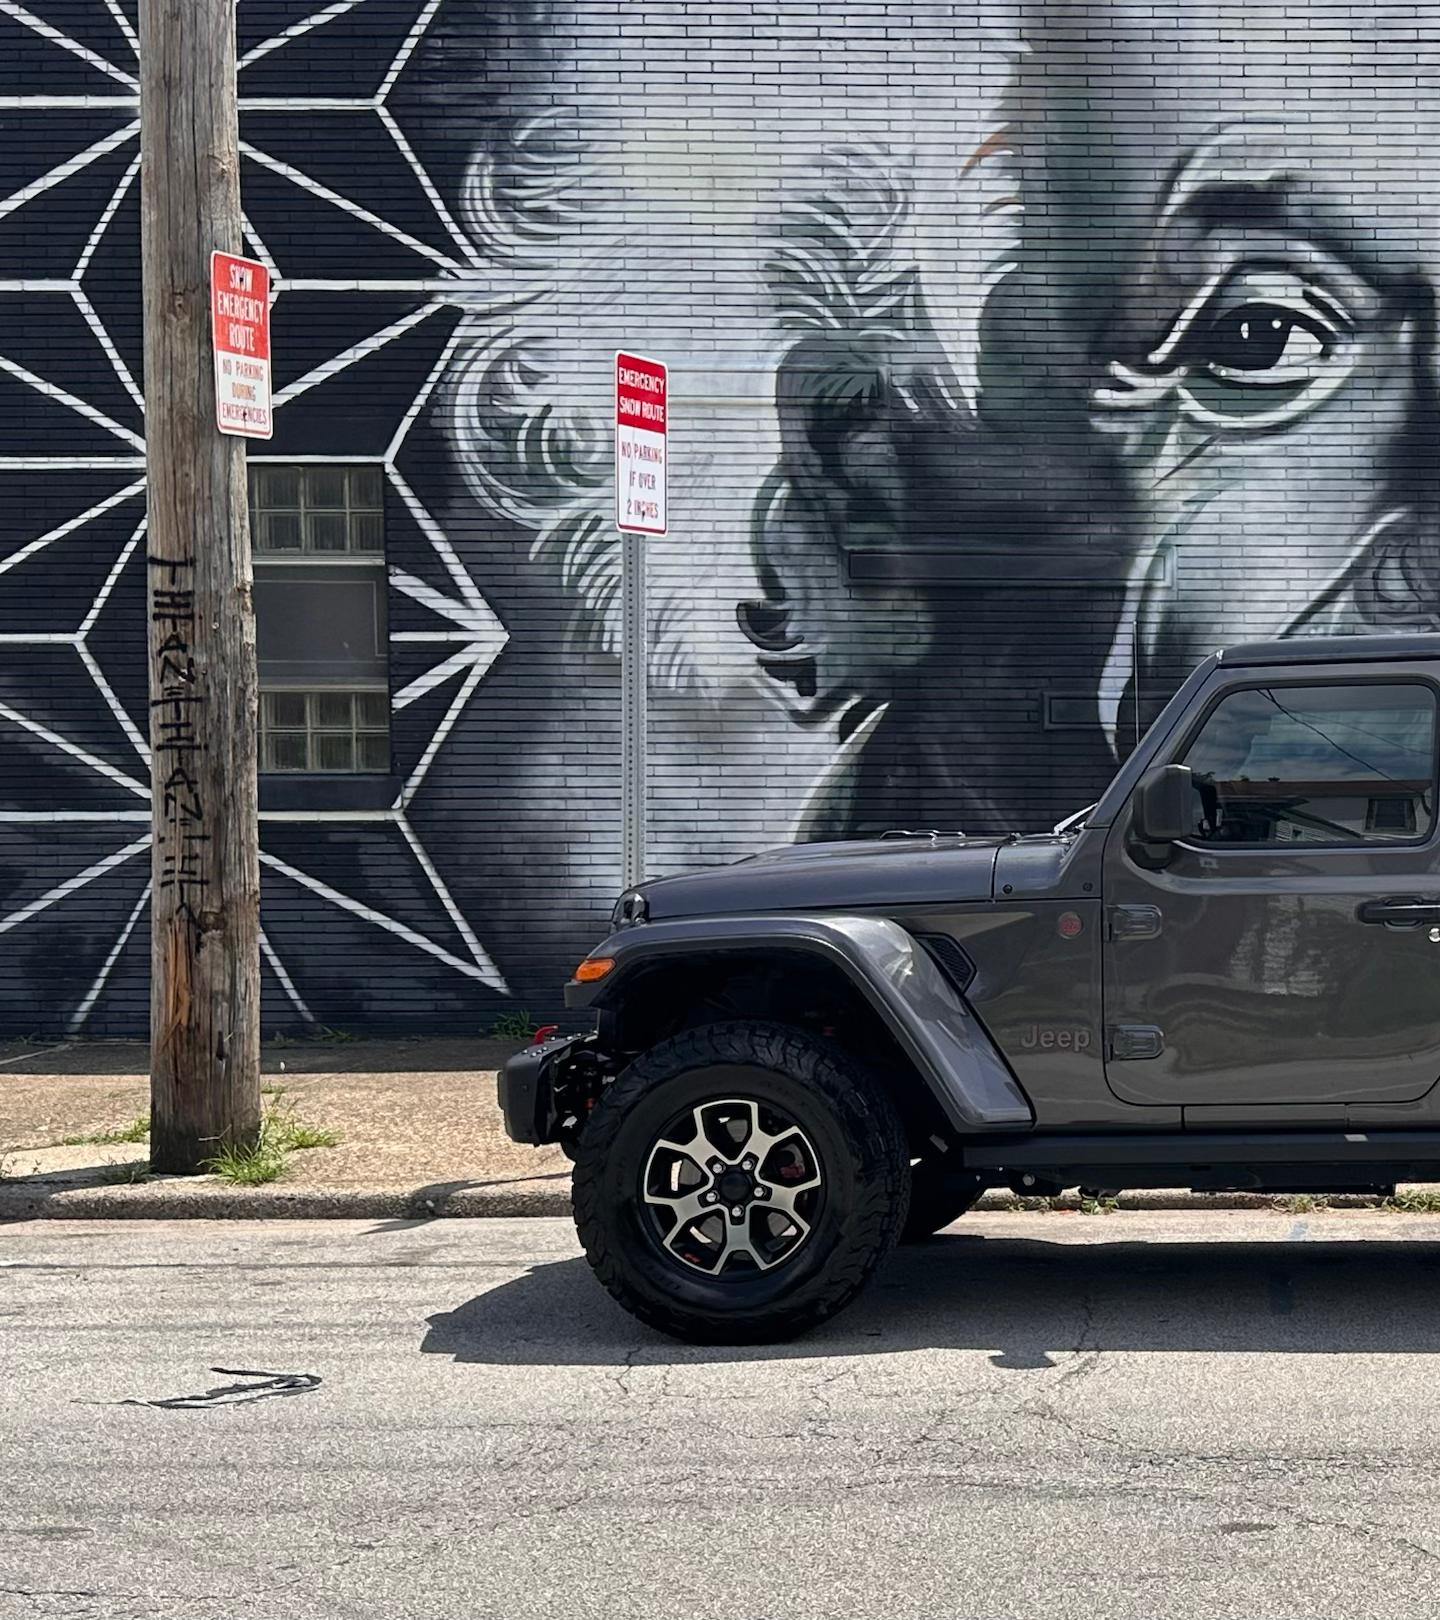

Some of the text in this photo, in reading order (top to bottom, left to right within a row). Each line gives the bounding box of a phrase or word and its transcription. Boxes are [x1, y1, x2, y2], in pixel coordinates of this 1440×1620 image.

[230, 264, 253, 292] SNOW
[218, 292, 264, 324] EMERGENCY
[230, 324, 254, 351] ROUTE
[223, 360, 263, 381] NO PARKING
[619, 367, 664, 394] EMERGENCY
[232, 382, 256, 401] DURING
[222, 402, 266, 424] EMERGENCIES
[620, 396, 664, 422] SNOW ROUTE
[622, 441, 662, 464] NO PARKING
[630, 471, 656, 490] IF OVER
[627, 500, 658, 518] 2 INCHES
[1021, 1024, 1090, 1052] Jeep
